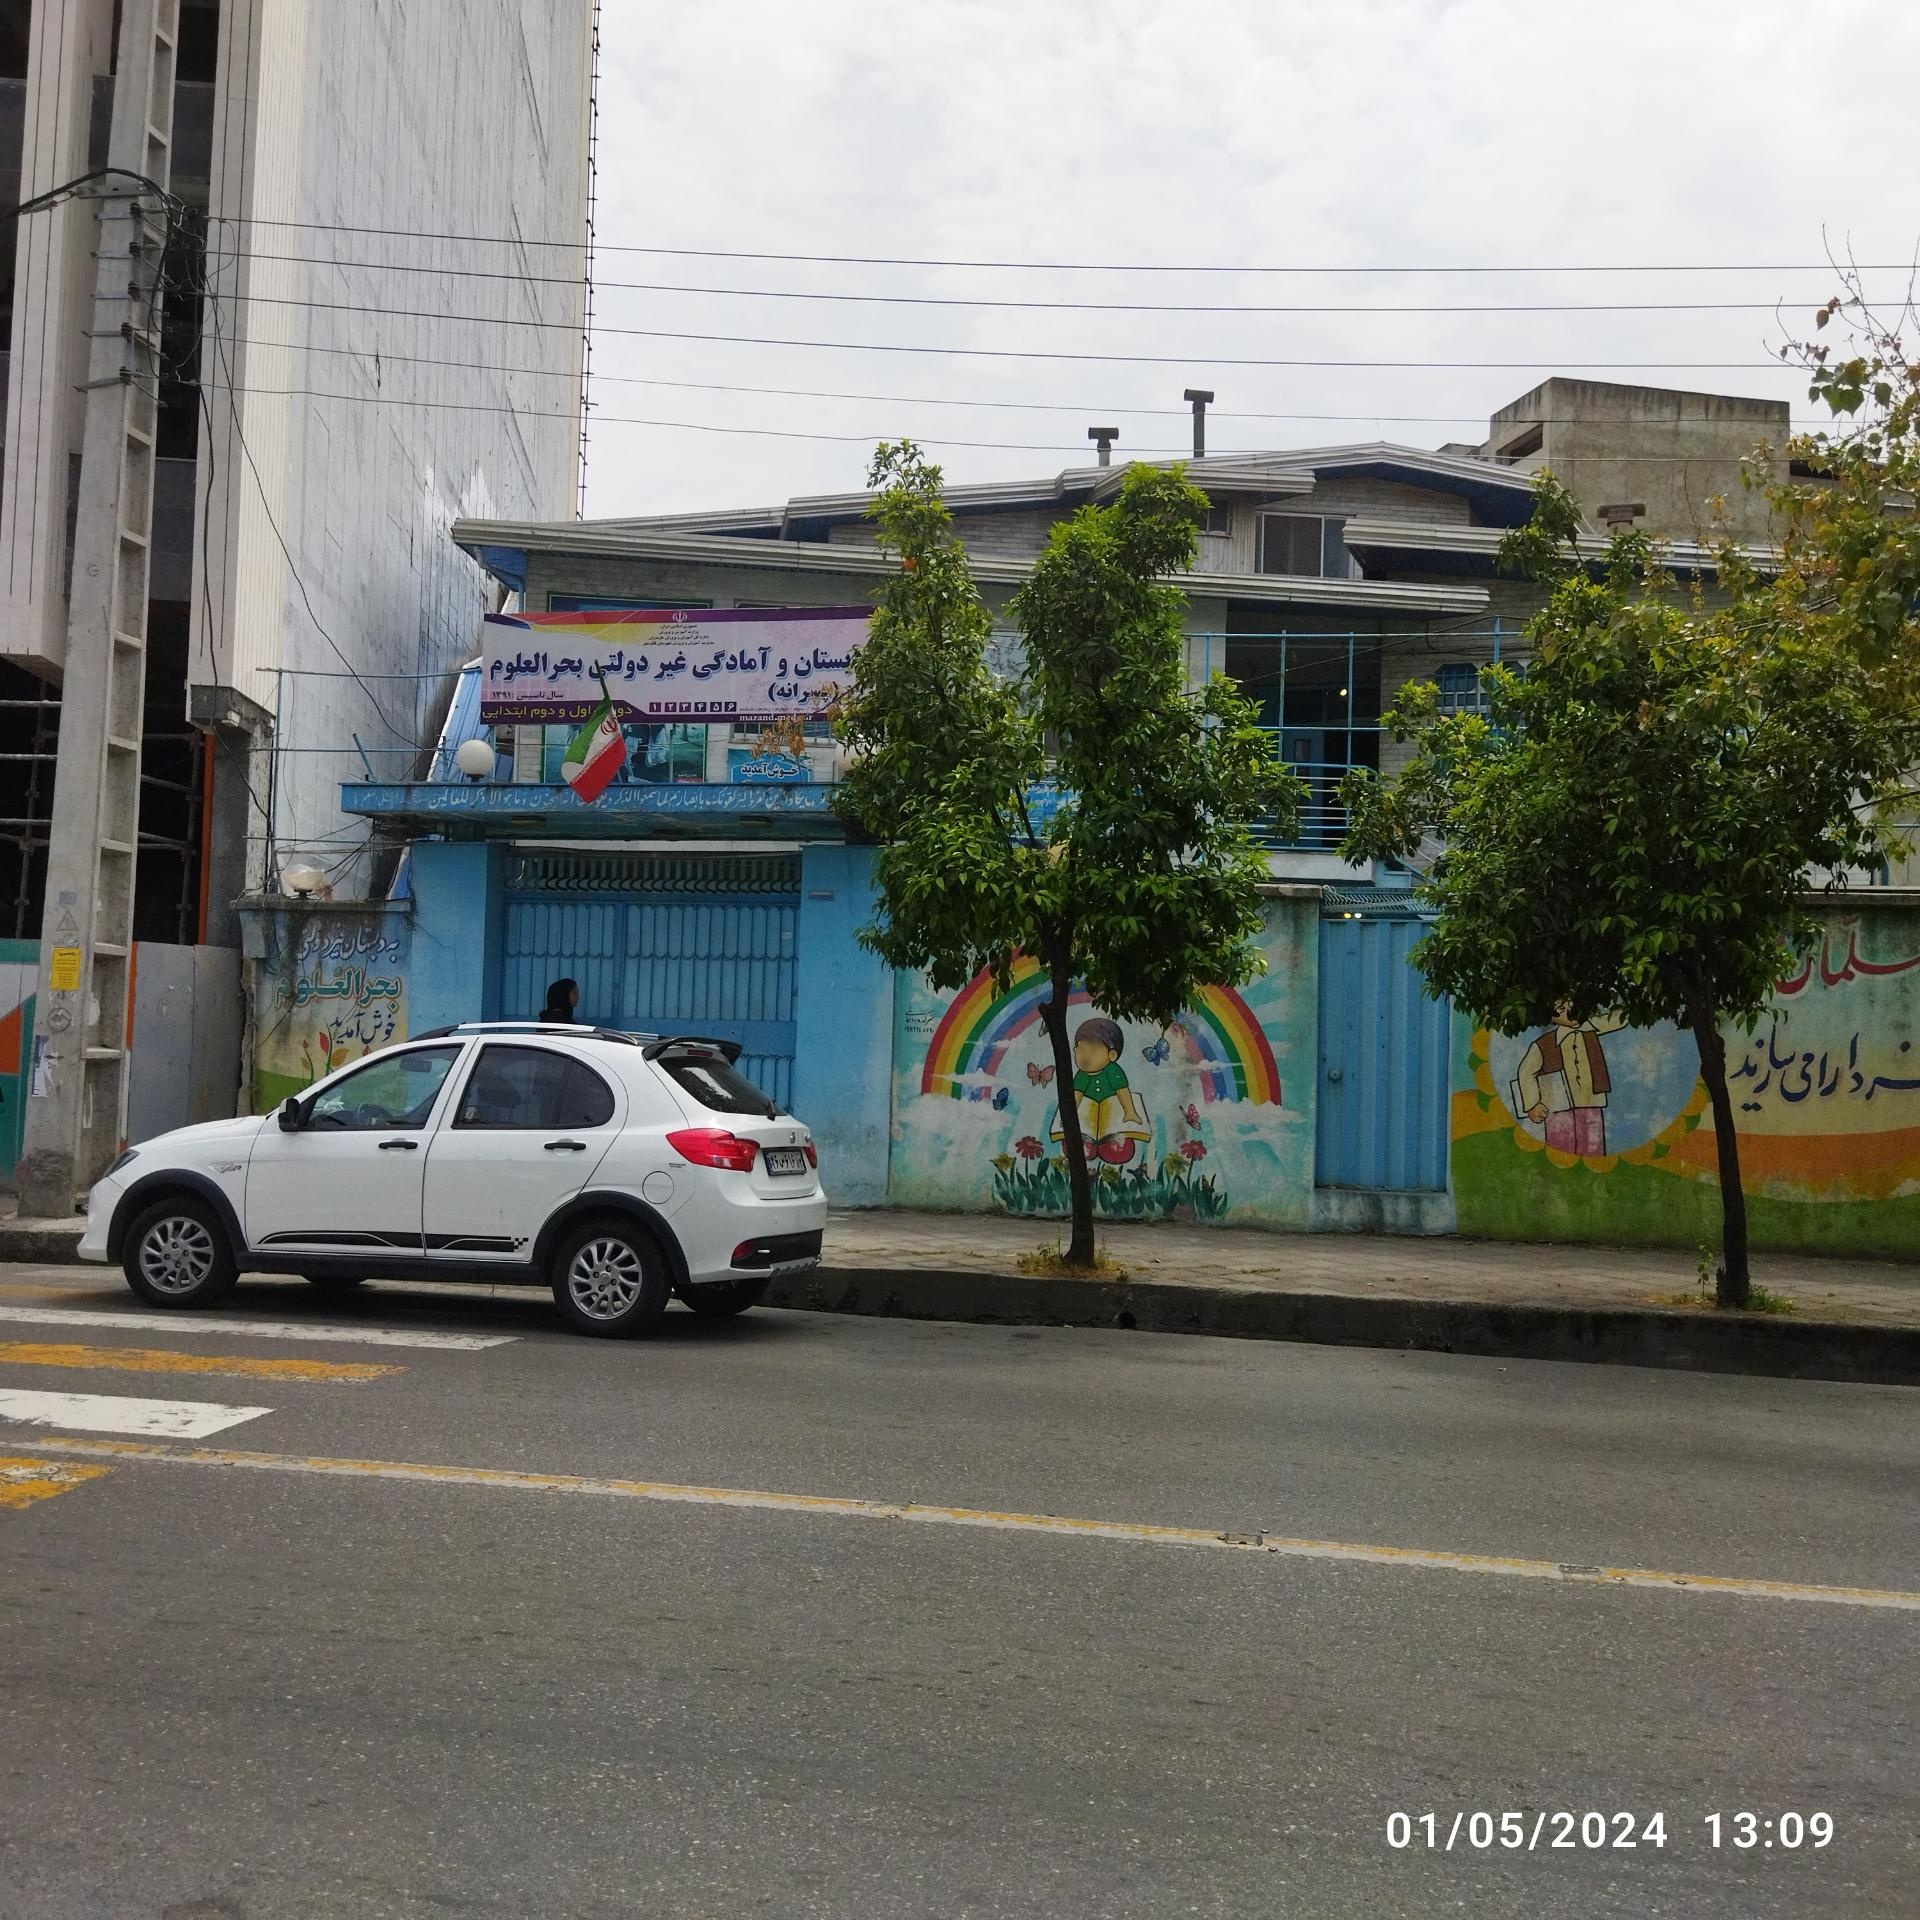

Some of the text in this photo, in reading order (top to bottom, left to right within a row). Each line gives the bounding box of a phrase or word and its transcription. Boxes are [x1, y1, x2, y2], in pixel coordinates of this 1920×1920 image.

[490, 646, 853, 680] بستان و آمادگی غیر دولتی بحرالعلوم
[549, 691, 564, 700] سال
[482, 706, 527, 720] ابتدایی
[530, 709, 555, 719] دوم
[558, 710, 565, 718] و
[569, 704, 591, 718] اول
[740, 713, 813, 721] mazand.med.ir
[741, 762, 799, 778] خوش آمدید
[343, 925, 386, 962] دبستان
[274, 967, 403, 1015] بحرالعلوم
[329, 1009, 396, 1045] خوش آمدید
[1779, 1052, 1815, 1103] می
[1818, 1051, 1840, 1097] را
